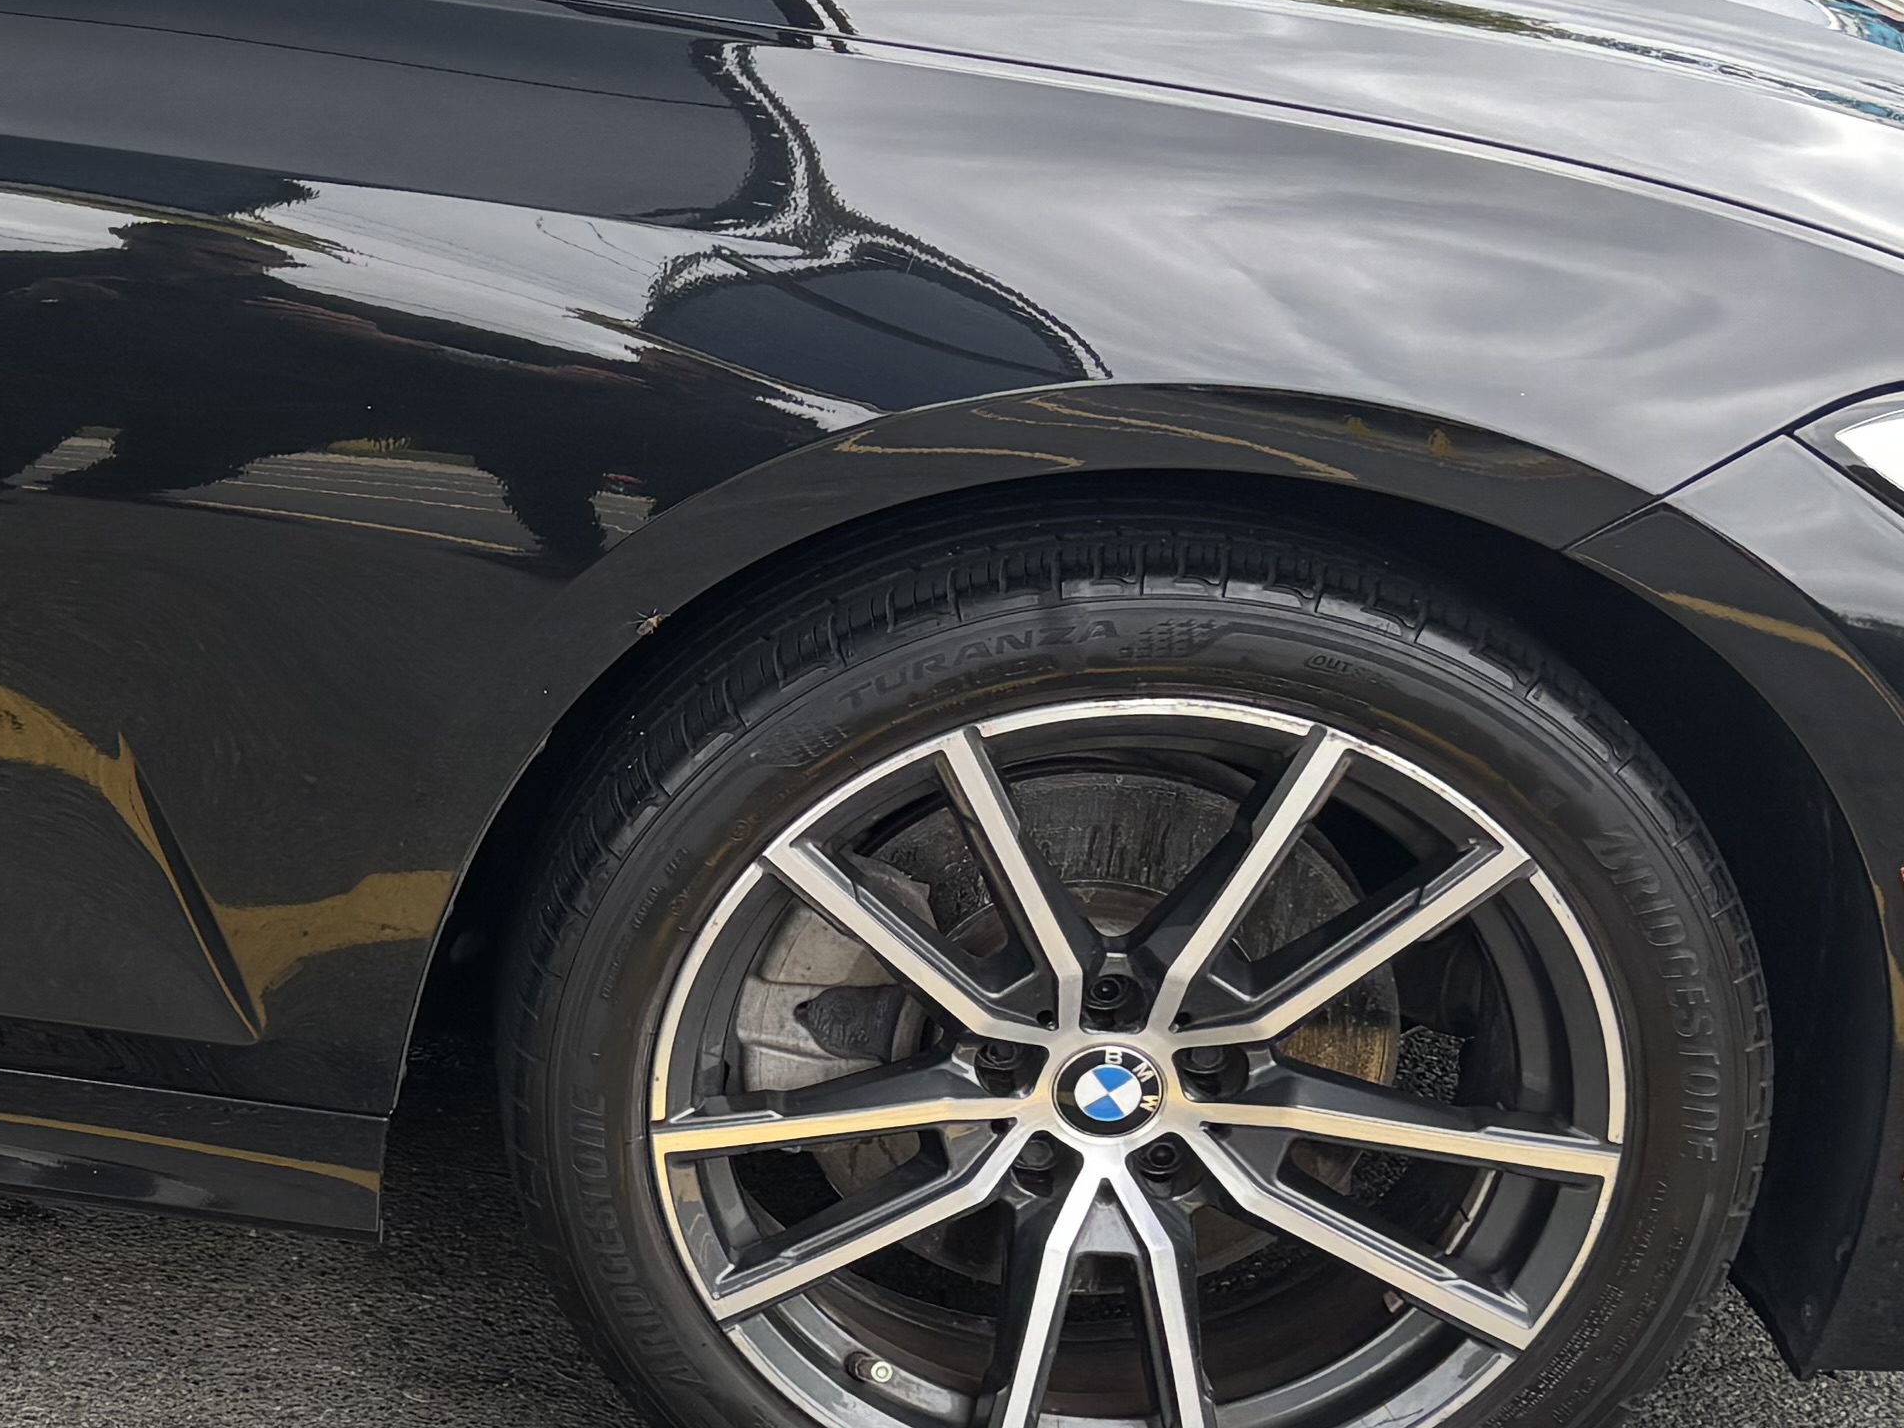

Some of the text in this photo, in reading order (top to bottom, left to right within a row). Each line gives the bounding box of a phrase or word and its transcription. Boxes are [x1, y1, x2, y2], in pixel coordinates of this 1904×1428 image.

[837, 619, 1122, 710] TURANZA
[1104, 1048, 1159, 1112] BMW
[1583, 829, 1723, 1164] BRIDGESTONE
[569, 1083, 708, 1384] BRIDGESTONE
